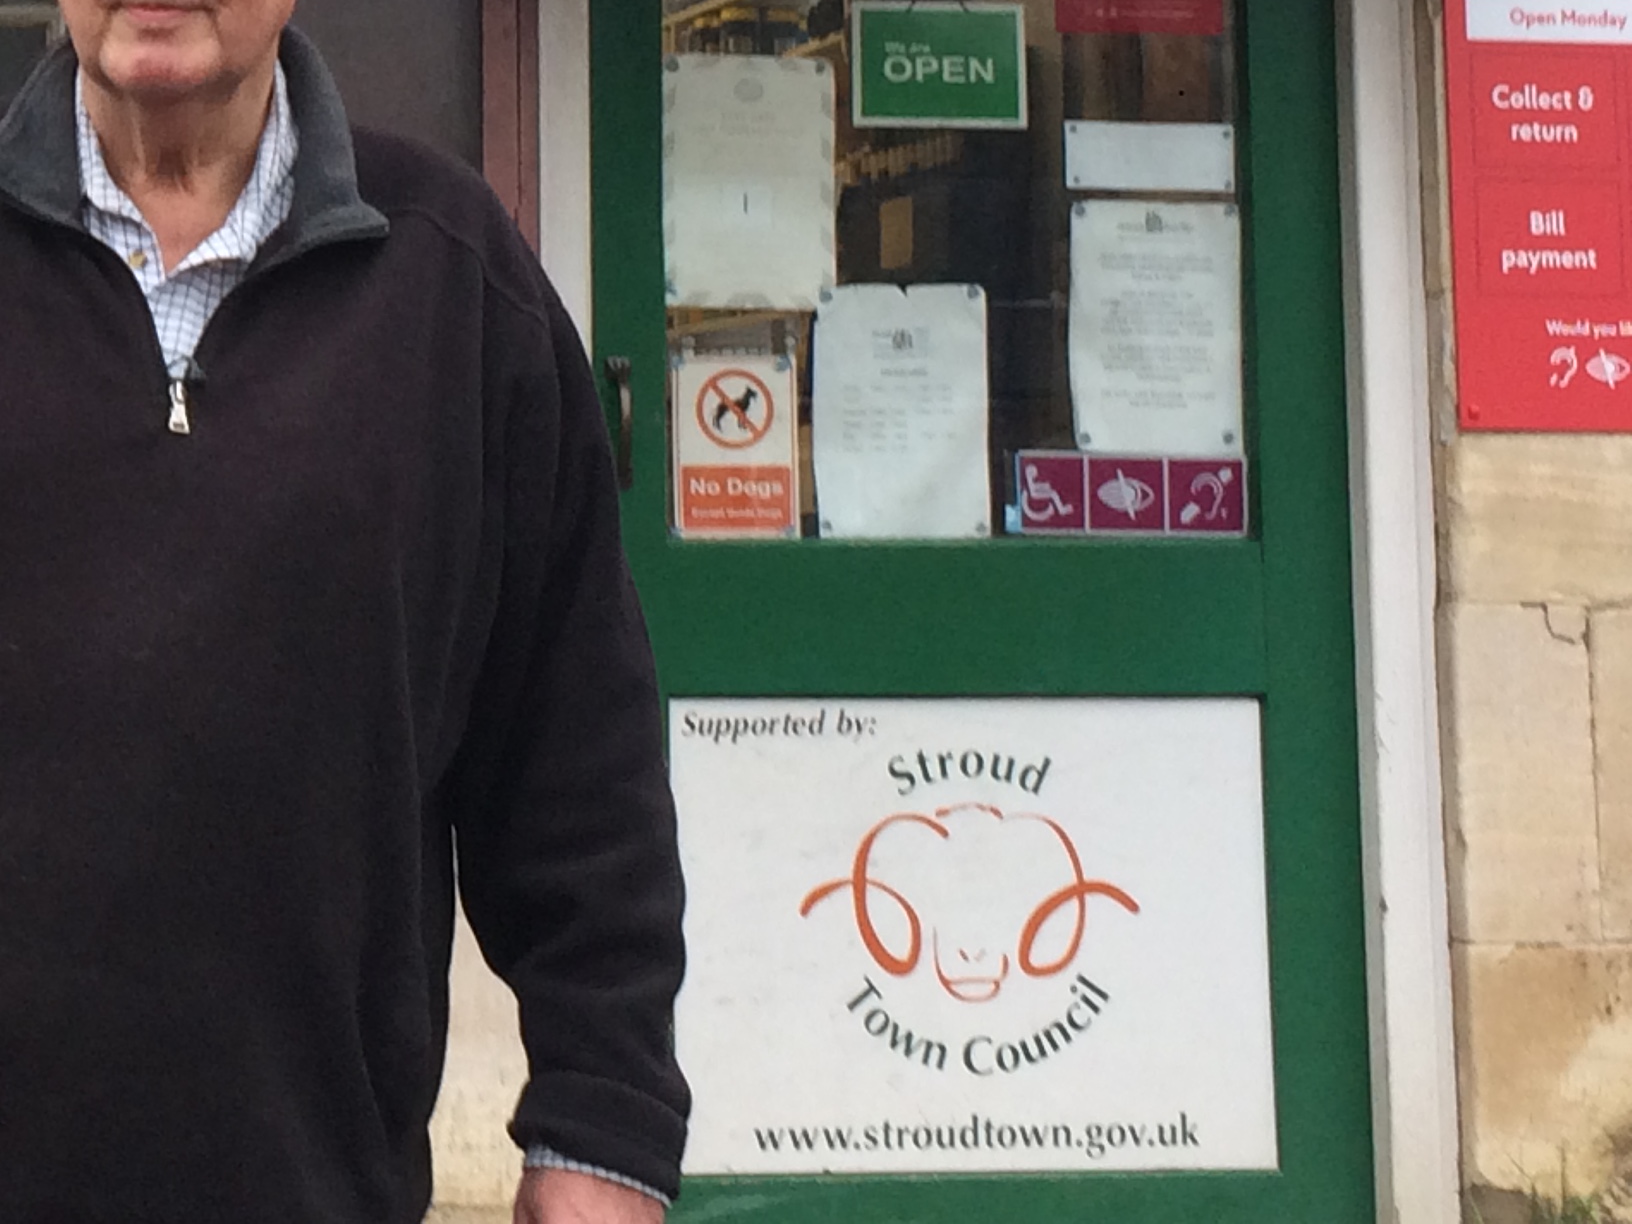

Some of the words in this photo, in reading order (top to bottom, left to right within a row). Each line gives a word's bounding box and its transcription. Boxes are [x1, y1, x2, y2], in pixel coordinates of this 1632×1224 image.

[1509, 6, 1557, 30] Open
[1560, 9, 1627, 32] Monday
[883, 54, 995, 84] OPEN
[1491, 83, 1572, 111] Collect
[1577, 85, 1594, 112] &
[1510, 121, 1578, 144] return
[1529, 209, 1565, 236] Bill
[1501, 248, 1597, 275] payment
[1545, 318, 1590, 337] Would
[1592, 324, 1617, 341] you
[689, 477, 721, 495] No
[727, 477, 784, 499] Dogs
[681, 707, 825, 745] Supported
[836, 707, 877, 745] by:
[887, 748, 1051, 796] Stroud
[844, 974, 948, 1072] Town
[962, 972, 1112, 1077] Council
[752, 1109, 1202, 1158] www.stroudtown.gov.uk
